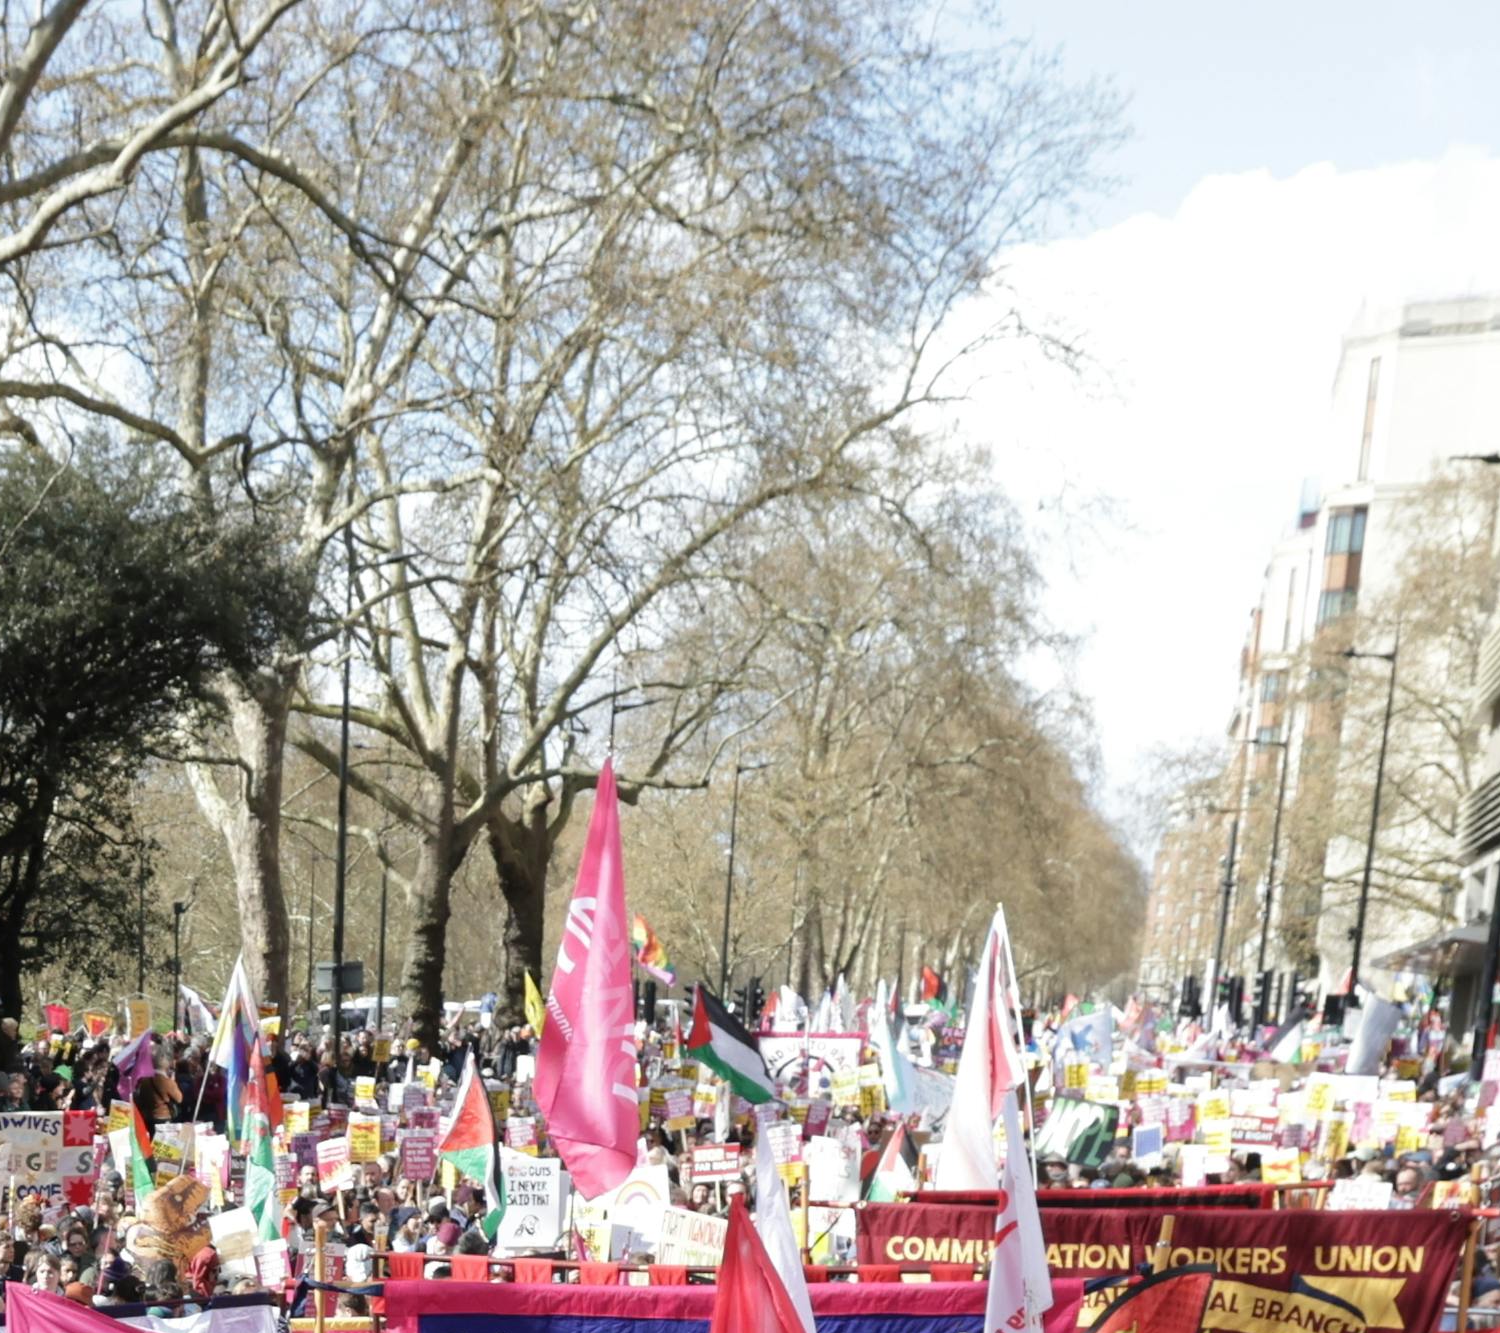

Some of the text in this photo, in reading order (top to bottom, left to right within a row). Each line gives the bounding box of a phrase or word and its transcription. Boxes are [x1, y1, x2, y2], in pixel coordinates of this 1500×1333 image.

[518, 1180, 547, 1192] NEVER
[532, 1193, 550, 1206] THAT
[1145, 1243, 1287, 1276] WORKERS
[1315, 1244, 1424, 1274] UNION
